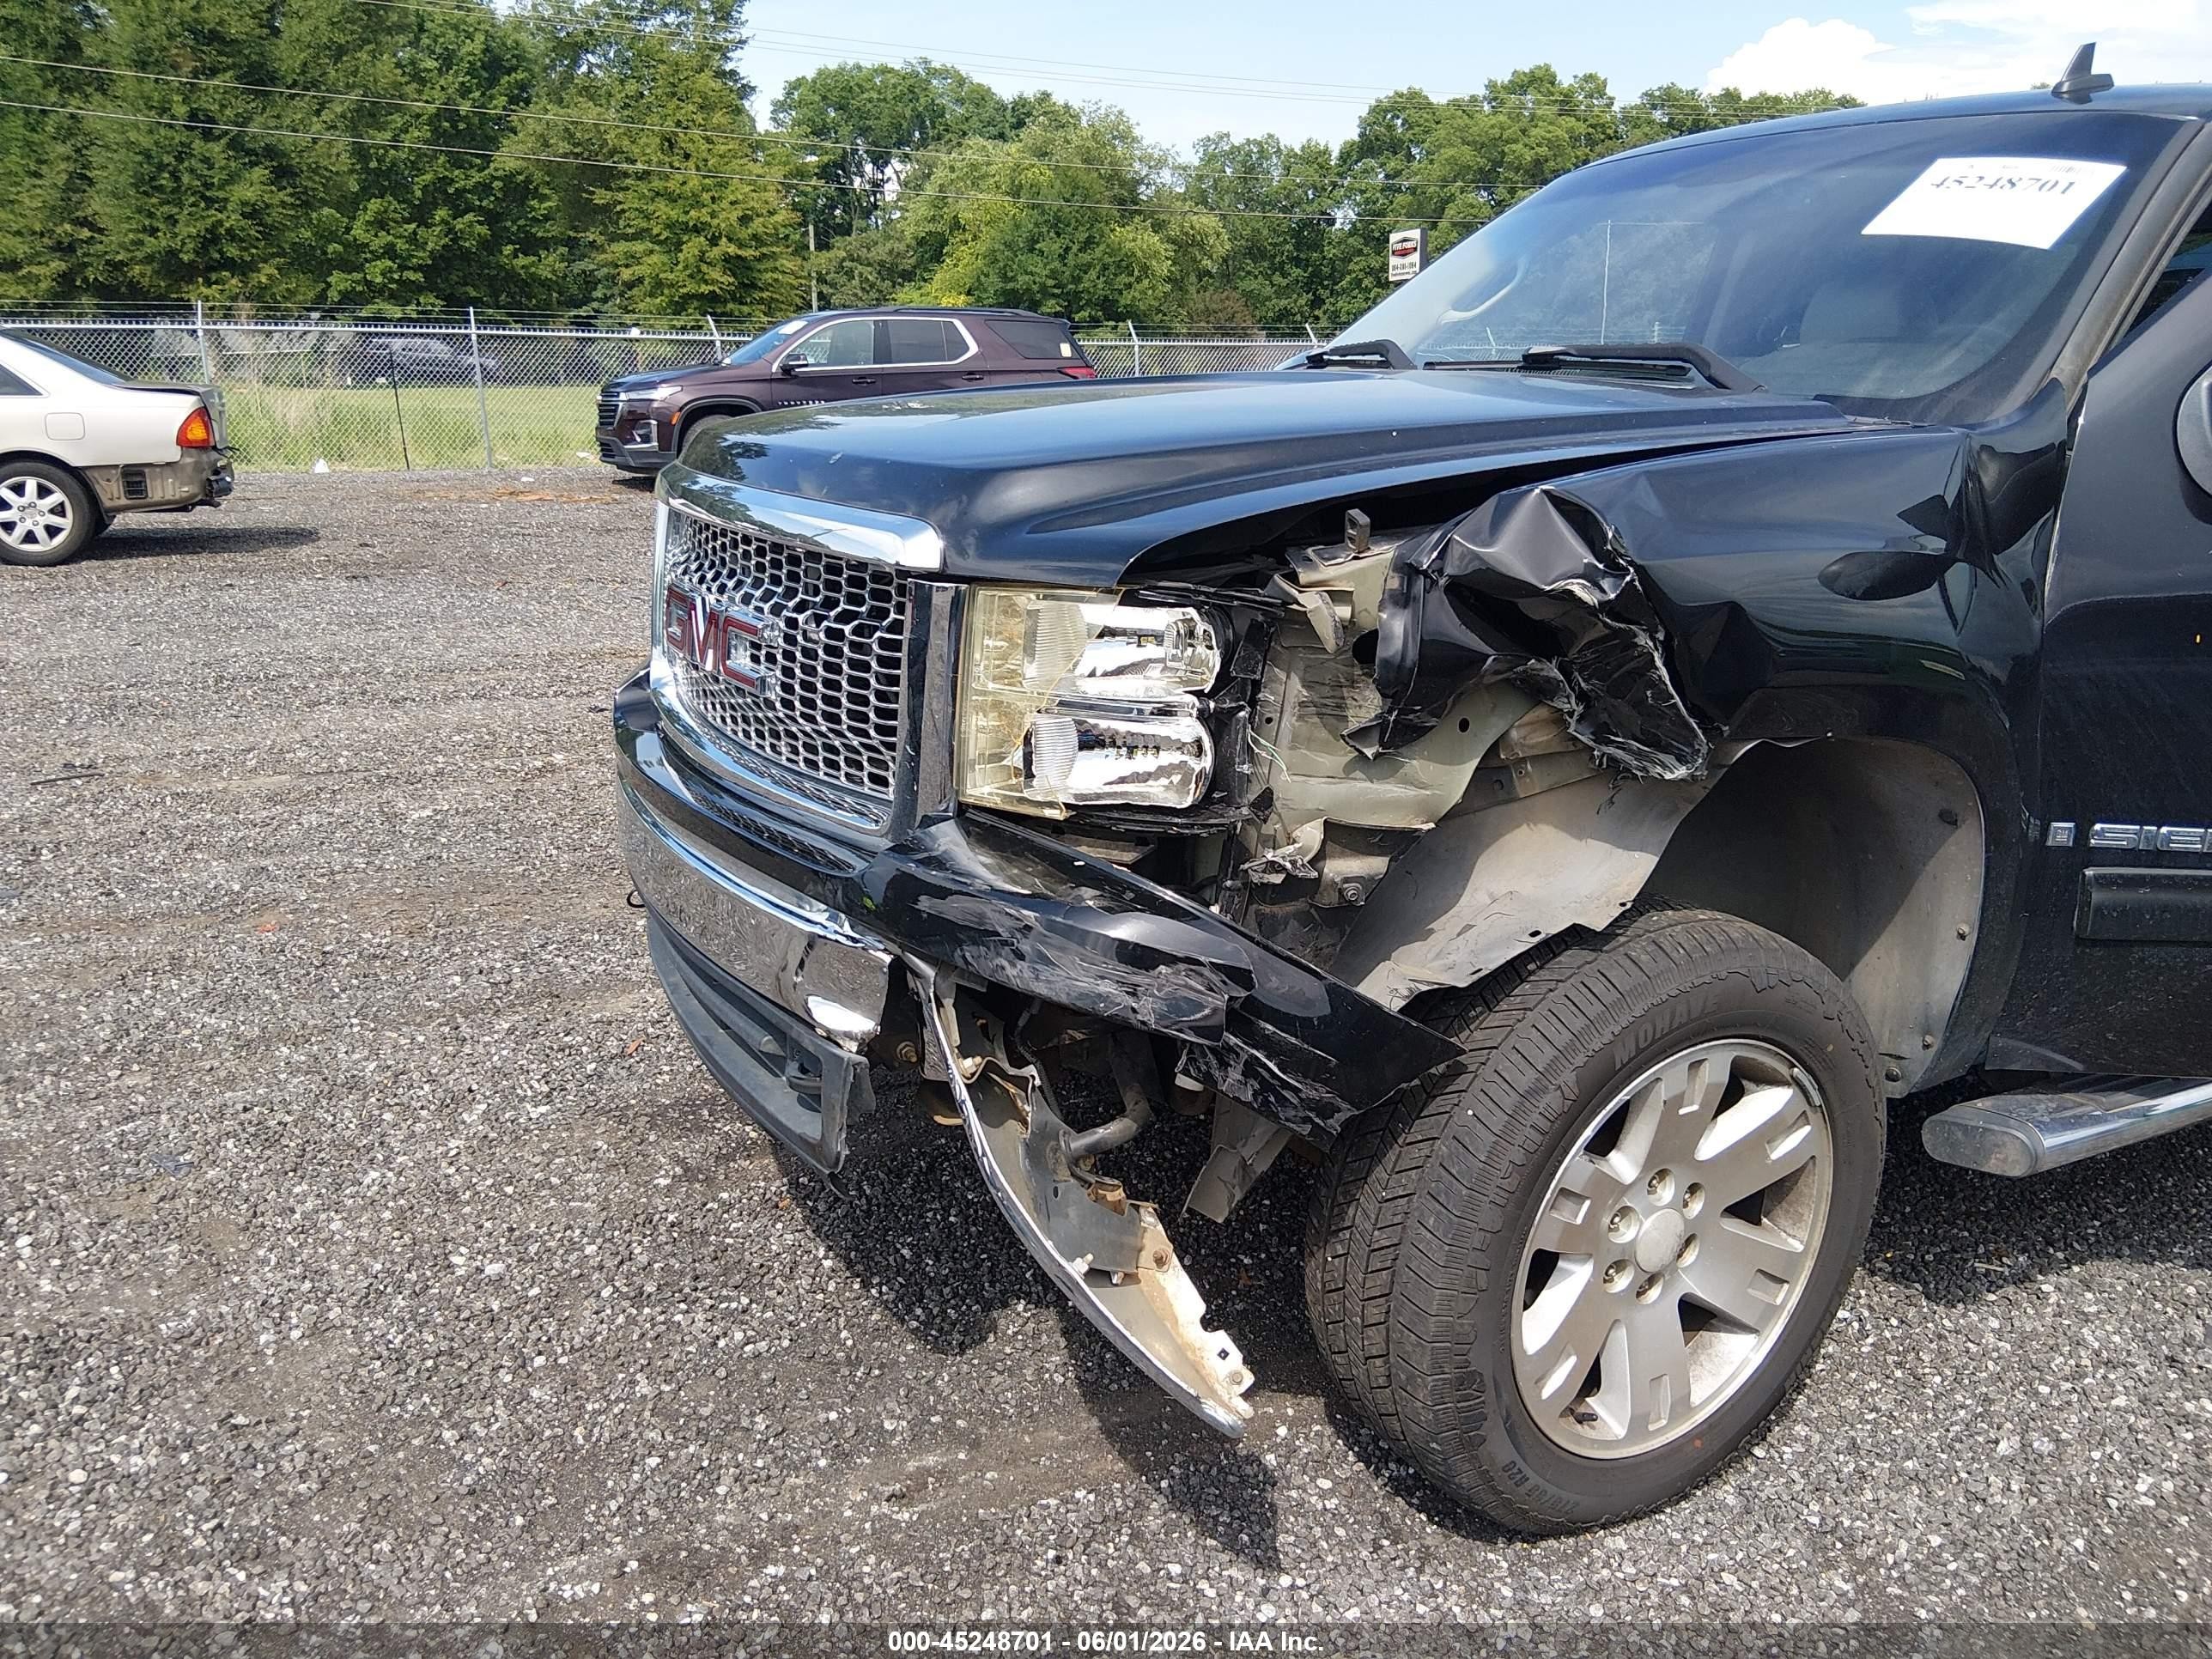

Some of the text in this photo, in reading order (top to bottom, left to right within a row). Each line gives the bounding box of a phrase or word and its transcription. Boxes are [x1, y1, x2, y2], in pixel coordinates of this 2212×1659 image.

[1930, 175, 2075, 195] 45248701
[665, 583, 771, 697] GMC
[2088, 823, 2212, 853] SIE
[1501, 1461, 1529, 1488] R20
